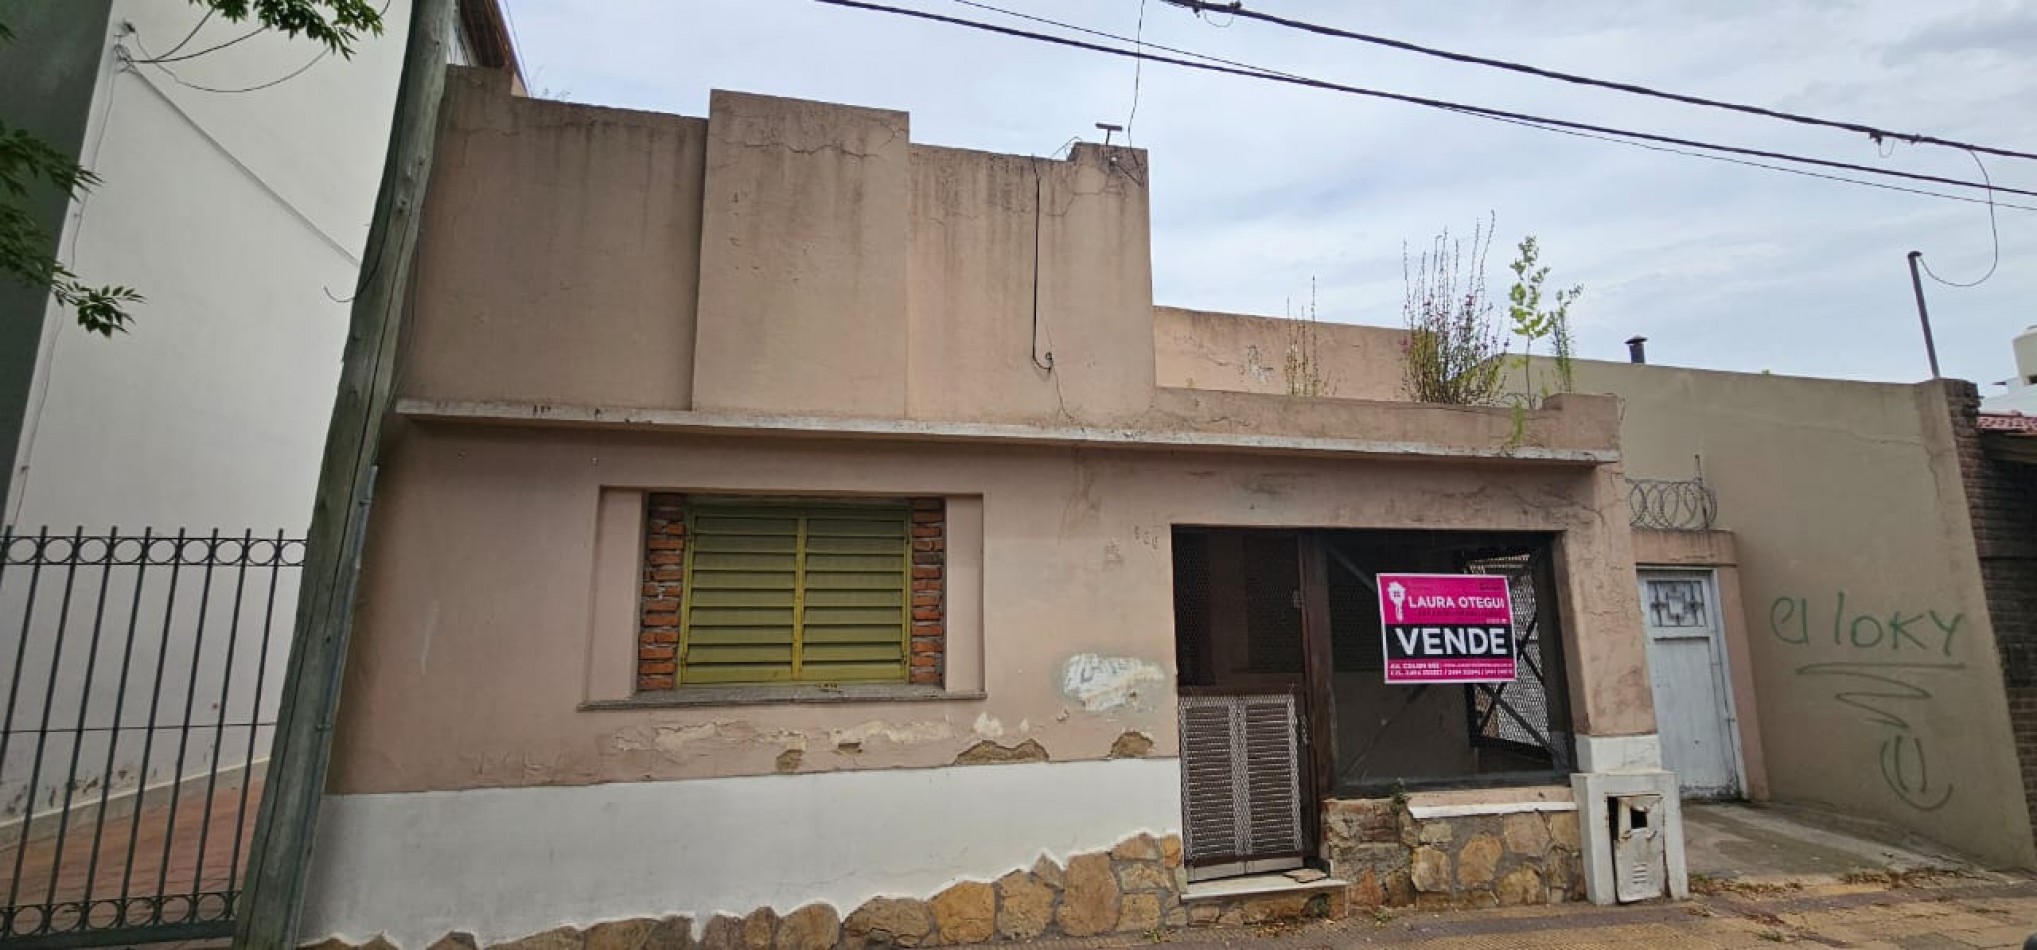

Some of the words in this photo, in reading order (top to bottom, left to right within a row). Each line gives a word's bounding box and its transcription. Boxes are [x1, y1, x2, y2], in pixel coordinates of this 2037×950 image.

[1408, 596, 1455, 609] LAURA
[1458, 597, 1505, 609] OTEGUI
[1394, 628, 1508, 655] VENDE
